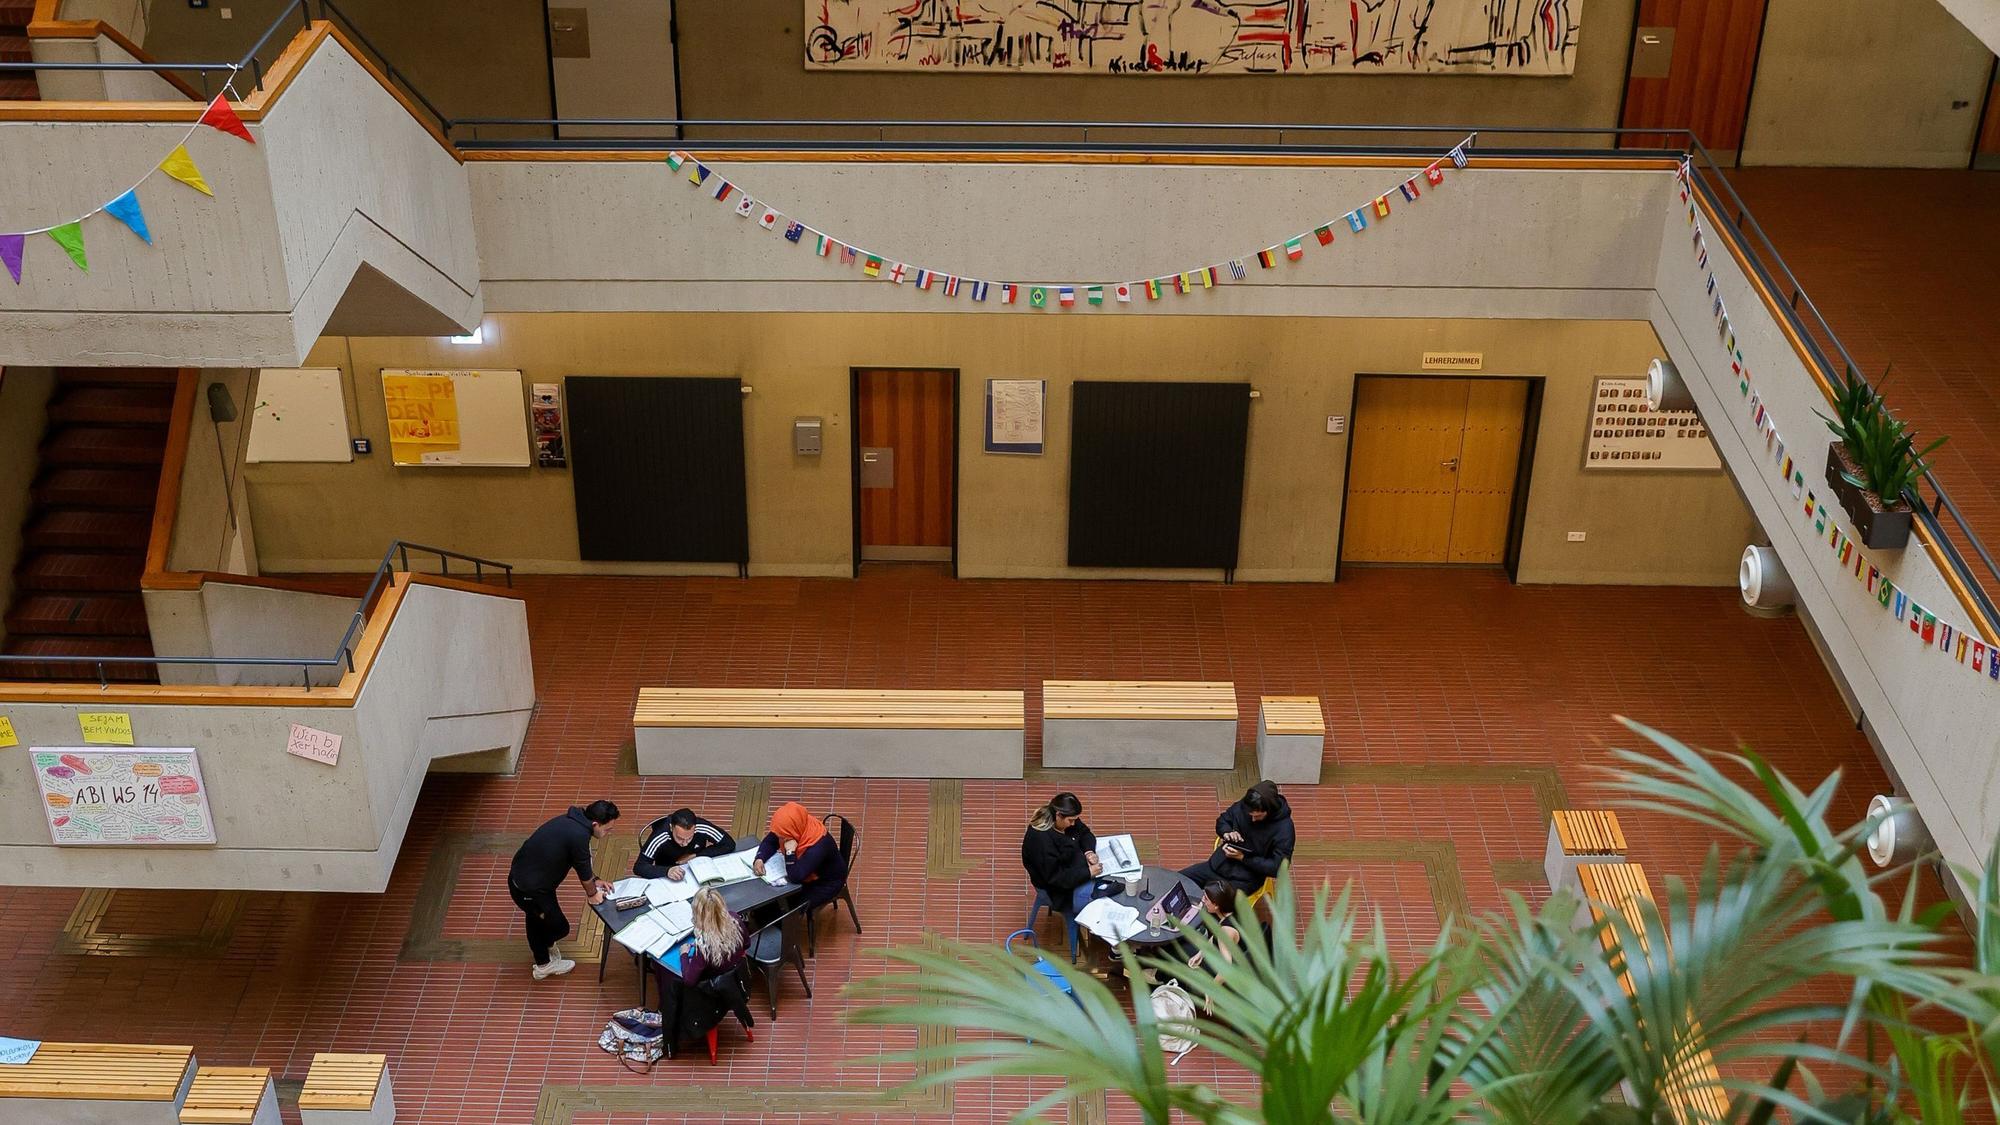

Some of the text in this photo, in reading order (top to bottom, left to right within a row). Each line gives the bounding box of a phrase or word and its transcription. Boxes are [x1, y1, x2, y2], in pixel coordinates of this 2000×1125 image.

[1424, 357, 1480, 365] LEHRERZIMMER
[388, 402, 435, 419] DEN
[76, 785, 106, 804] ABI
[112, 786, 136, 804] WS
